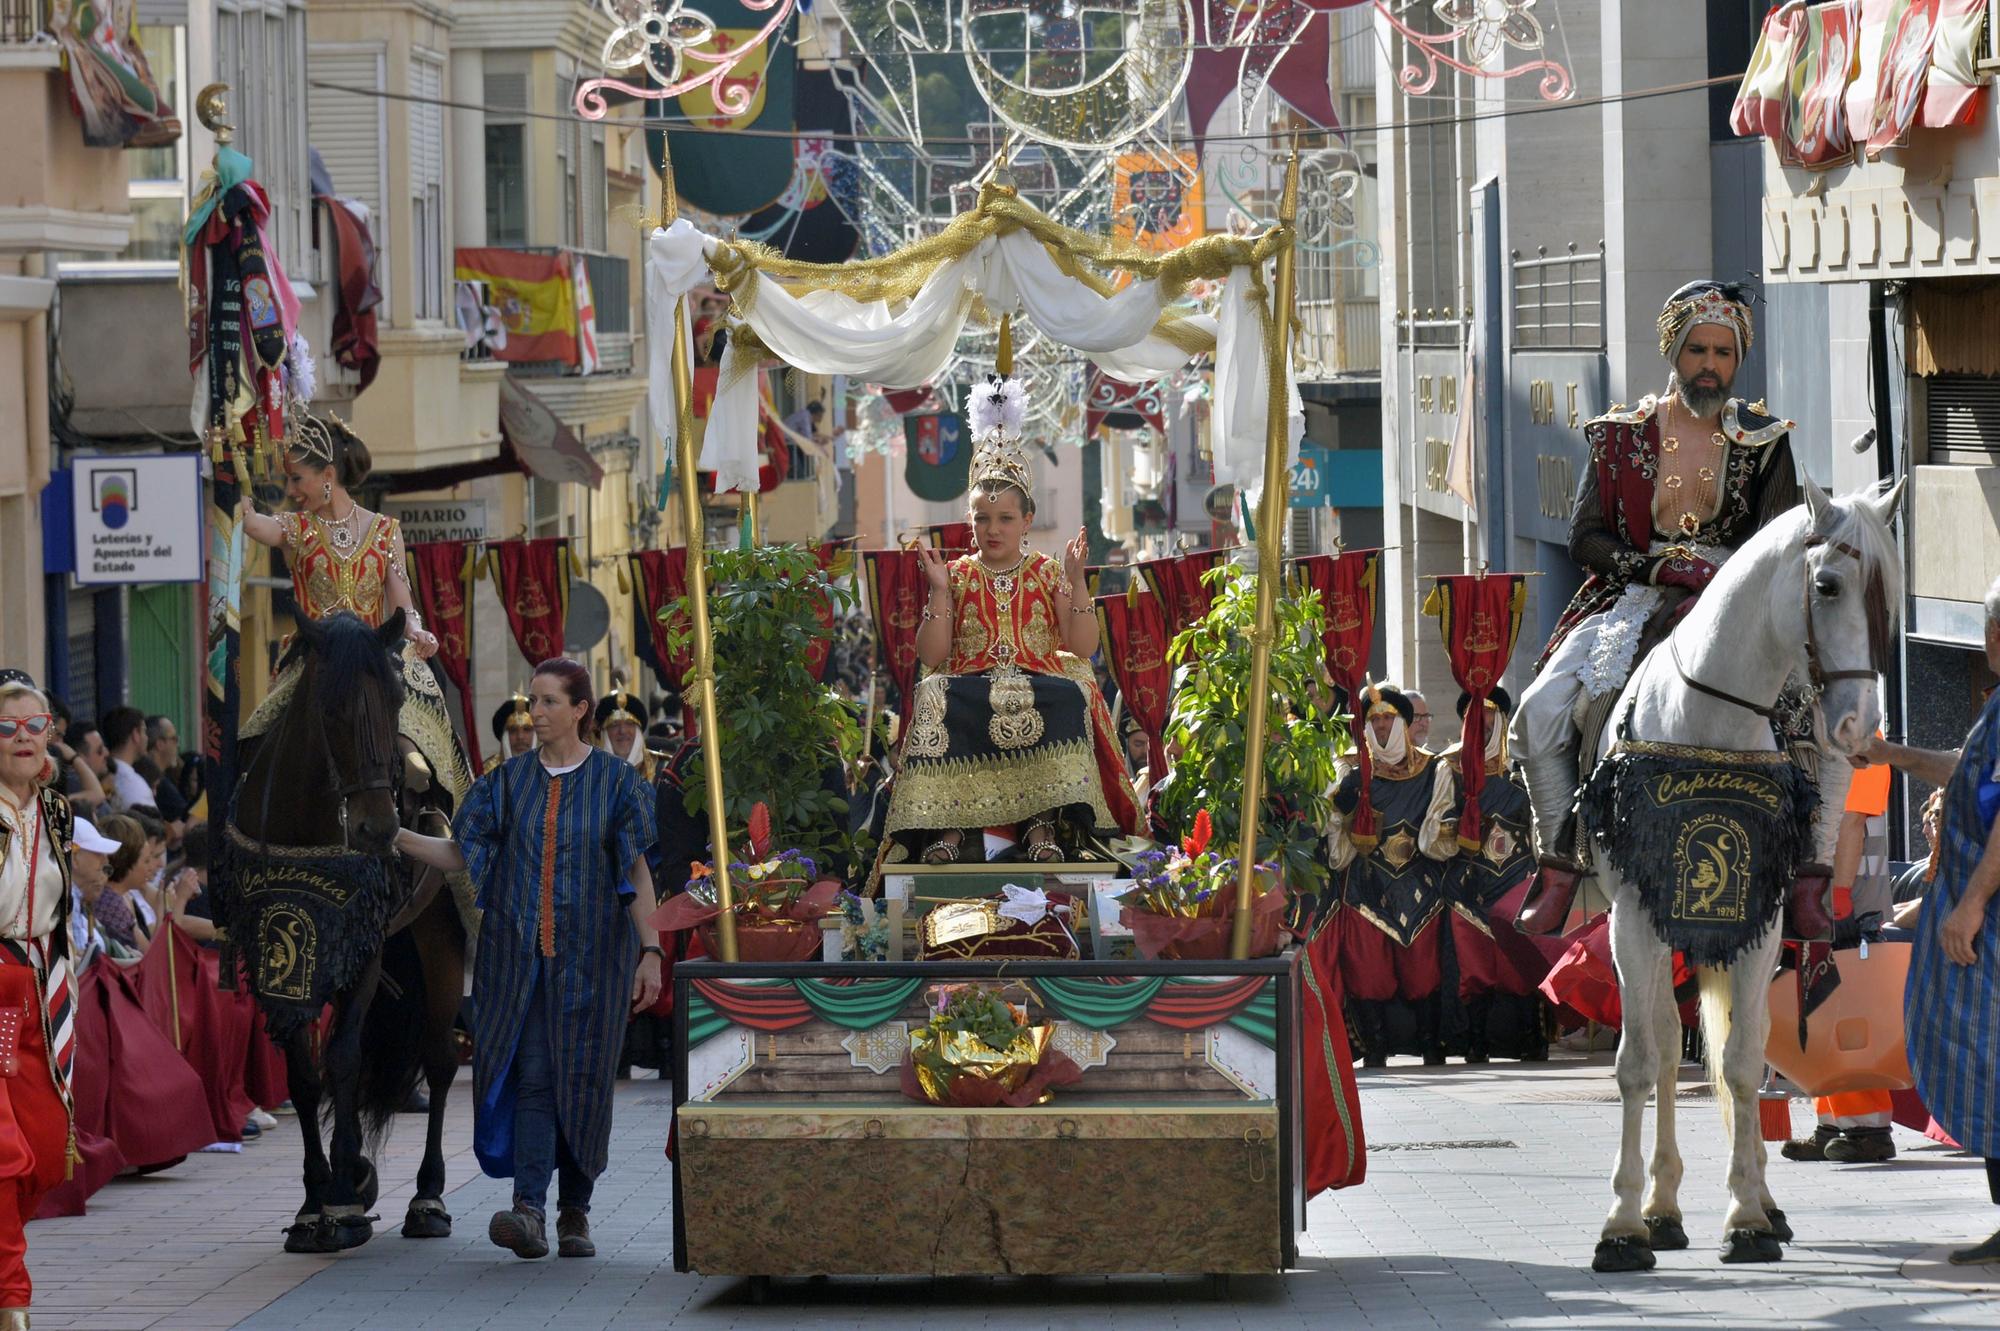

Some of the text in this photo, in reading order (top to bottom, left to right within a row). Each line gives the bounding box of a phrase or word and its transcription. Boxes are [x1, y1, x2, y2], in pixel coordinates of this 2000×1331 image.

[401, 508, 467, 523] DIARIO
[145, 534, 153, 546] y
[93, 546, 172, 560] Apuestas del
[93, 561, 136, 573] Estado
[1656, 772, 1779, 808] Capitania
[242, 867, 348, 901] Capitania
[1715, 906, 1737, 918] 1976
